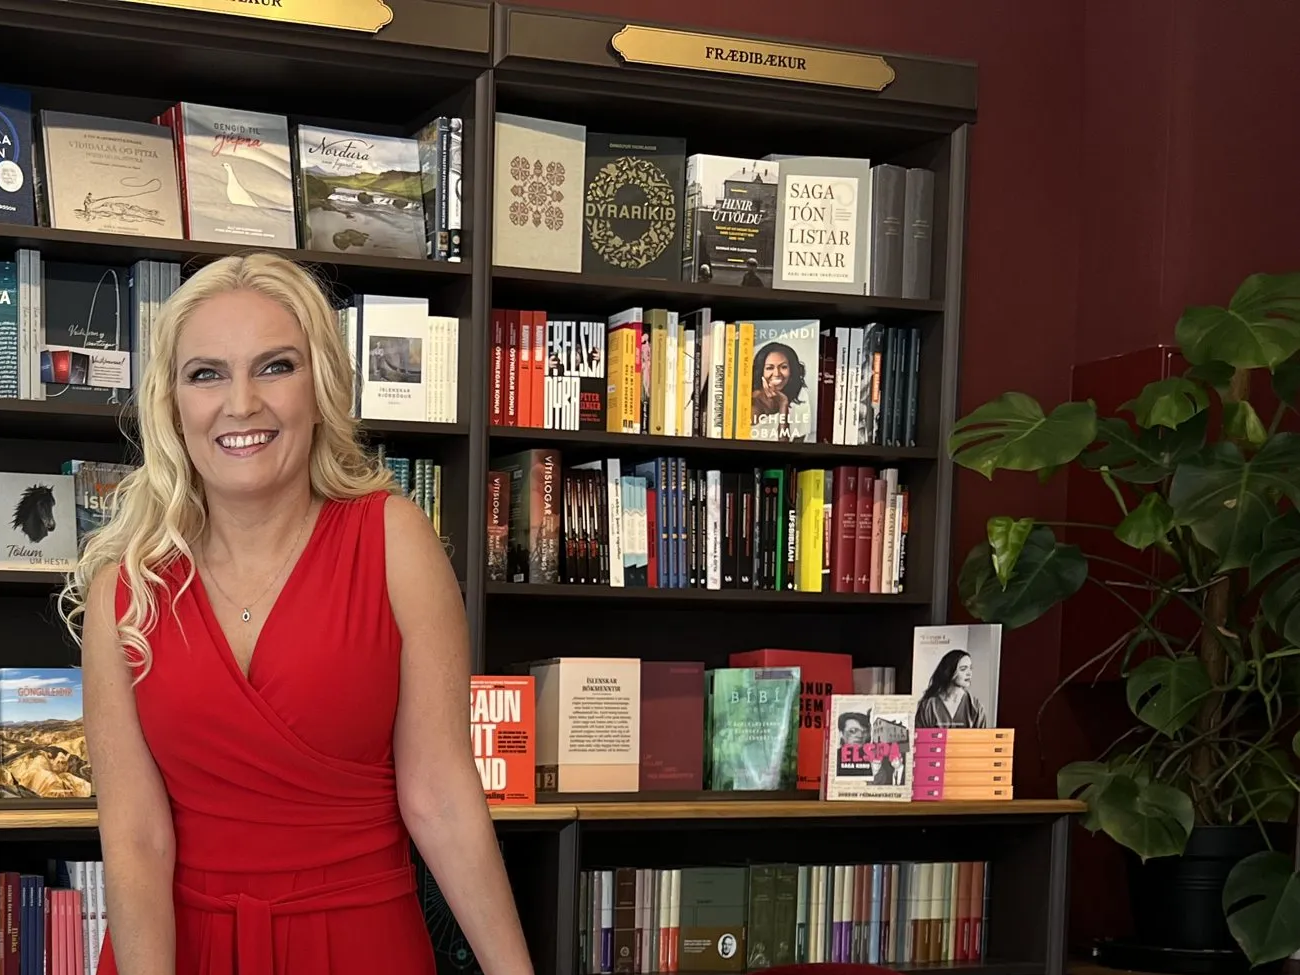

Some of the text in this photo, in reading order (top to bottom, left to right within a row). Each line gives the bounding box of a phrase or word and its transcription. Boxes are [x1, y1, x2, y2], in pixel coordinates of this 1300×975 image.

[705, 46, 807, 71] FRÆÐIBÆKUR
[247, 127, 261, 135] TIL
[790, 182, 835, 199] SAGA
[585, 201, 676, 222] DÝRARÍKIÐ
[721, 197, 754, 211] HINIR
[790, 201, 825, 222] TÓN
[711, 207, 763, 226] ÚTVÖLDU
[789, 226, 851, 246] LISTAR
[787, 251, 845, 268] INNAR
[750, 428, 800, 438] OBAMA
[544, 456, 553, 515] VÍTISLOGAR
[6, 545, 43, 558] Tölum
[586, 677, 618, 685] ÍSLENSKAR
